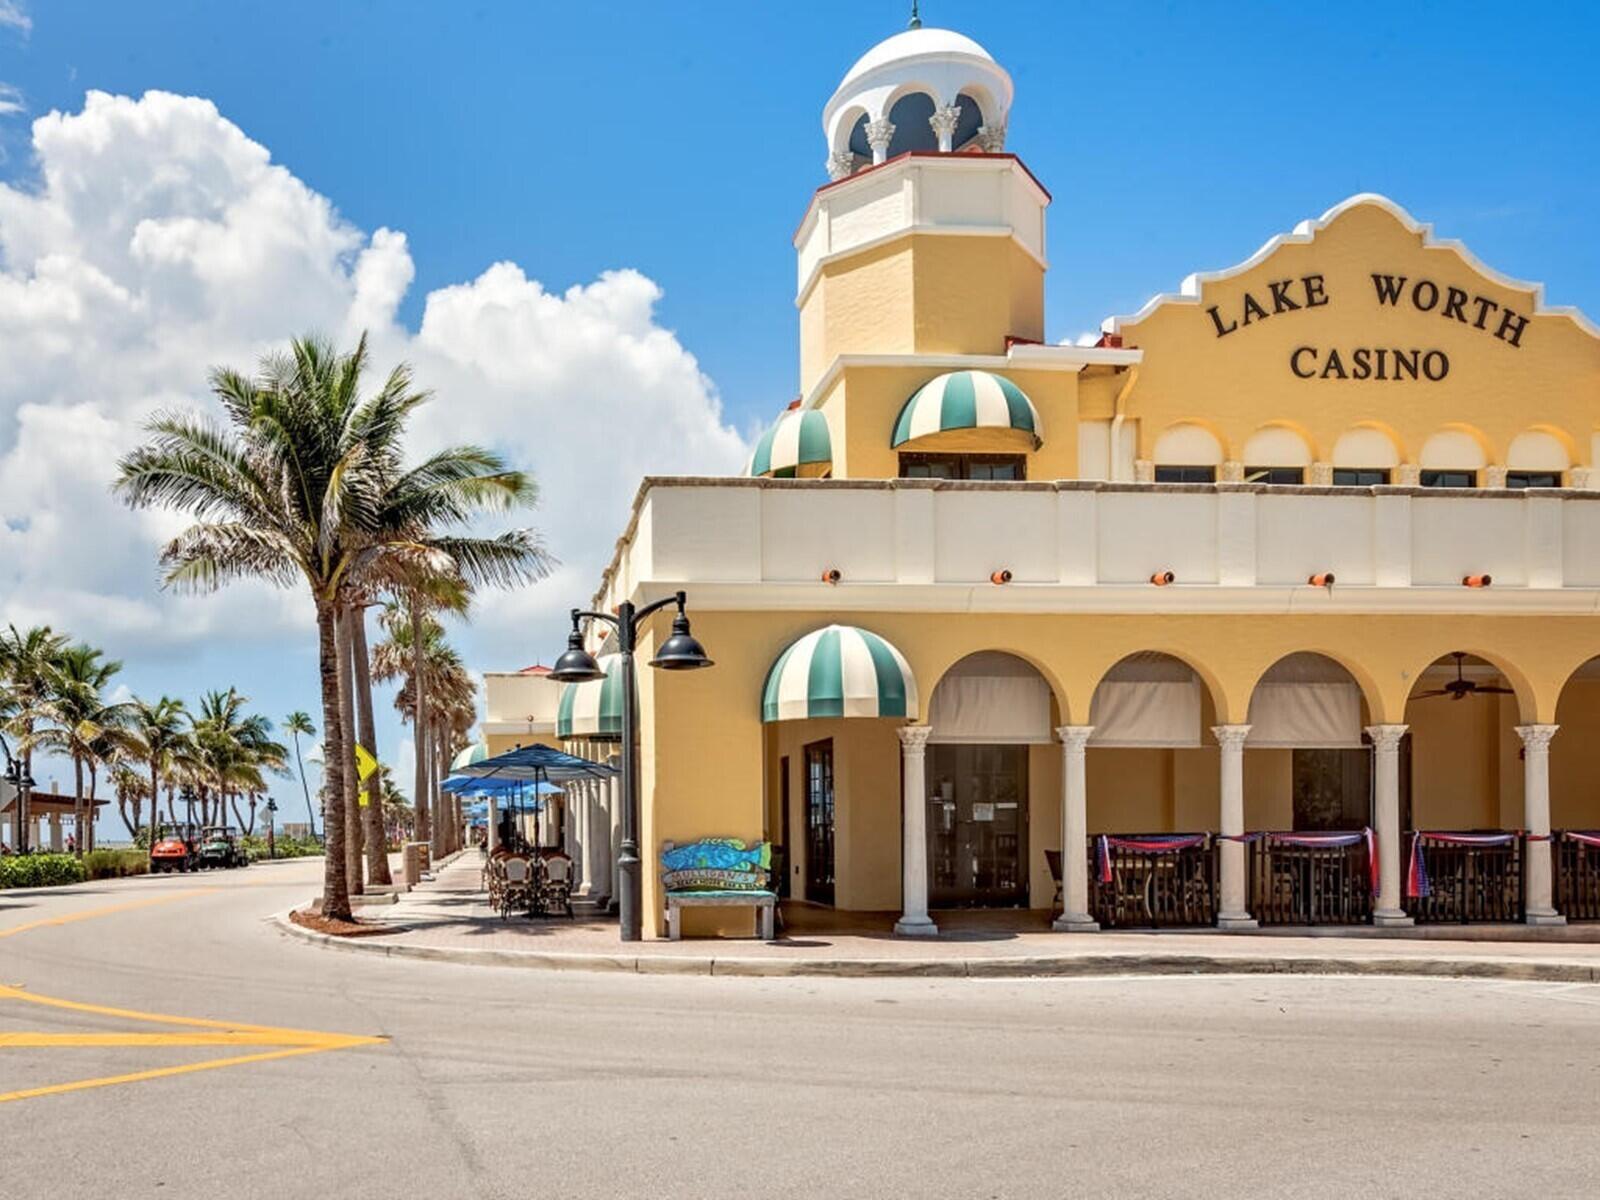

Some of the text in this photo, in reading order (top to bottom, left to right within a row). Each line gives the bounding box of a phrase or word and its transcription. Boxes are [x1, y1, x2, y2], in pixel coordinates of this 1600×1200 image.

[1206, 273, 1531, 348] LAKE WORTH
[1290, 346, 1450, 382] CASINO
